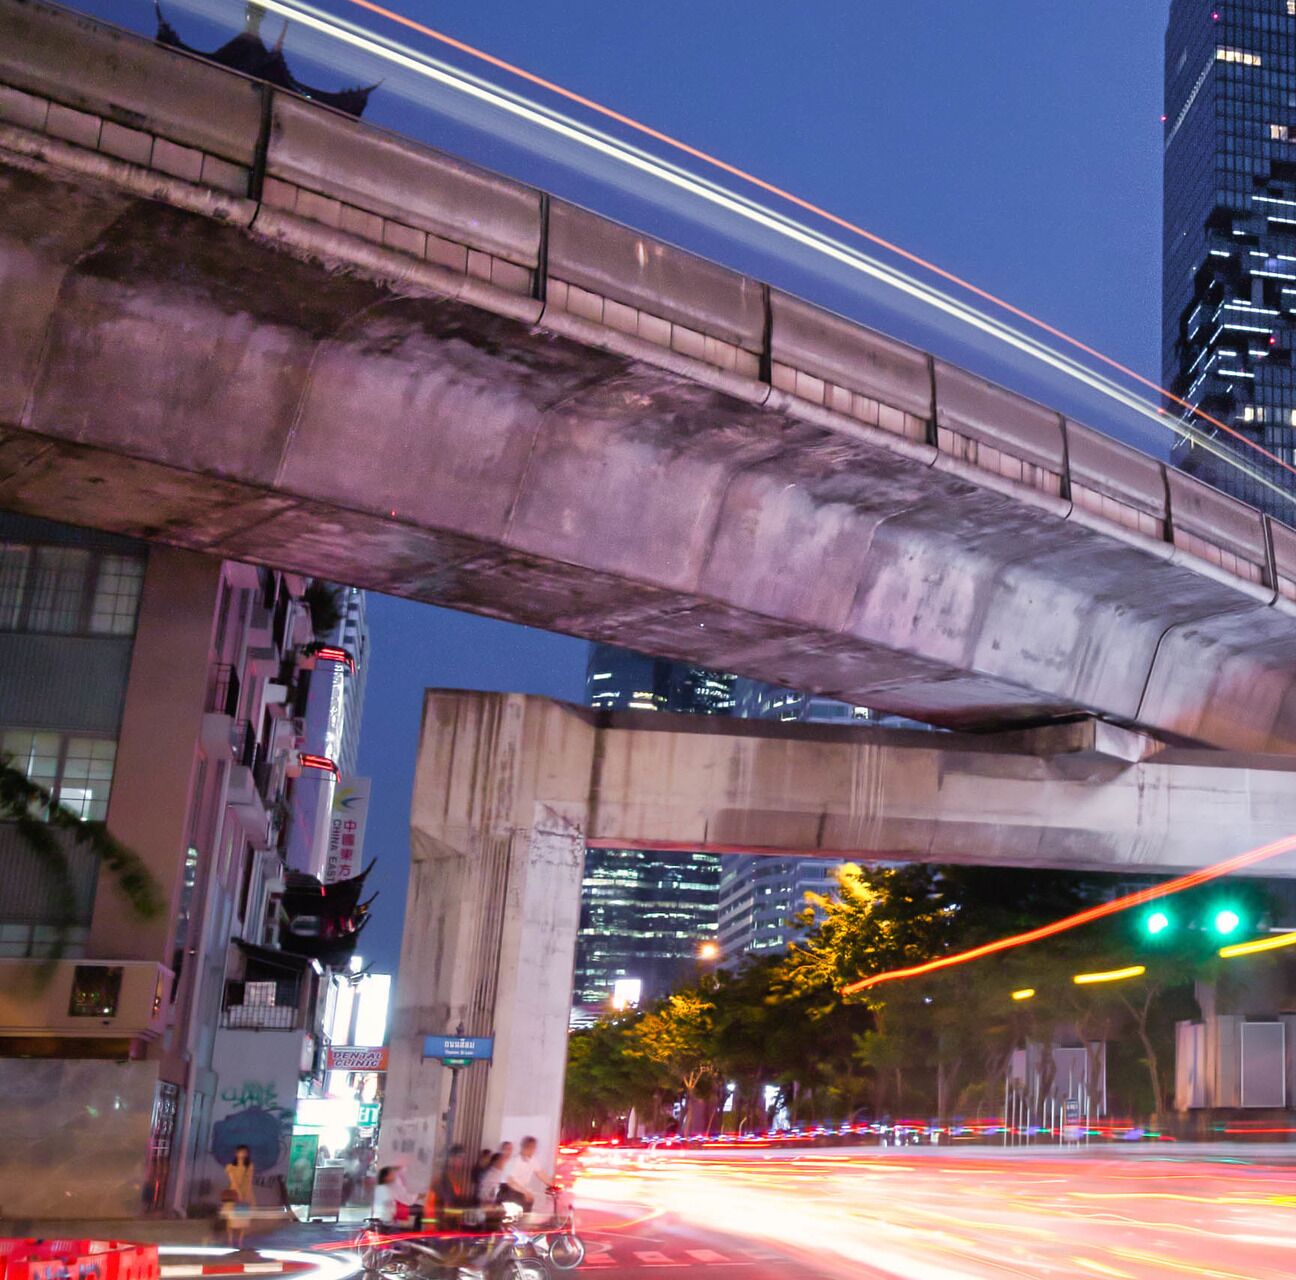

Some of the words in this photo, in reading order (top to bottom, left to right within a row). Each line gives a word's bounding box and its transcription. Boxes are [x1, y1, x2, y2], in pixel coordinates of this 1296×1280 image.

[330, 819, 342, 851] CHINA
[333, 1051, 384, 1060] DENTAL
[335, 1059, 380, 1067] CLINIC
